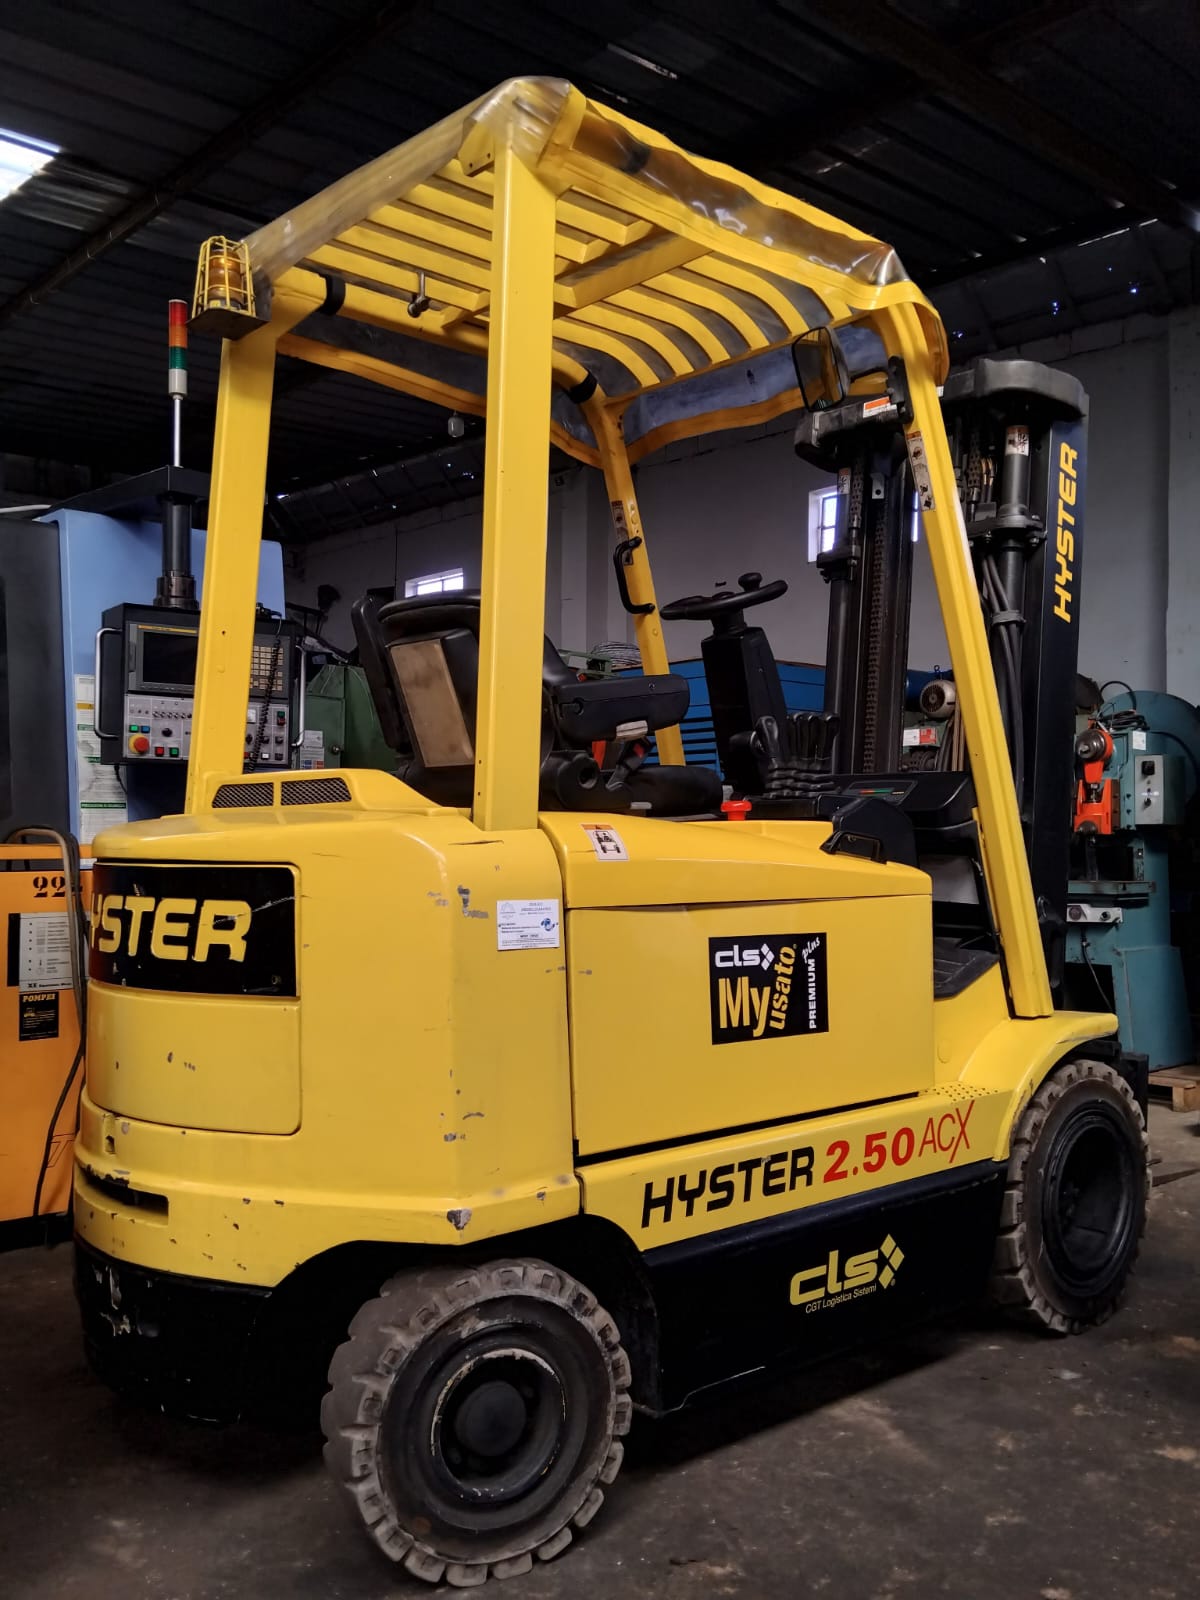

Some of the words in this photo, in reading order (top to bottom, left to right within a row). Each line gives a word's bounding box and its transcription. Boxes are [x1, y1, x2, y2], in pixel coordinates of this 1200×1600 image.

[1053, 441, 1078, 623] HYSTER
[33, 876, 83, 898] 22
[715, 944, 761, 968] cls
[718, 976, 771, 1037] My
[769, 946, 796, 1030] usato
[807, 958, 817, 1029] PREMIUM
[641, 1145, 814, 1229] HYSTER
[823, 1127, 915, 1184] 2.50
[918, 1100, 975, 1164] ACX
[789, 1249, 879, 1306] cls
[805, 1299, 822, 1314] CGT
[822, 1292, 852, 1307] Logistica
[853, 1283, 877, 1298] Sistemi
